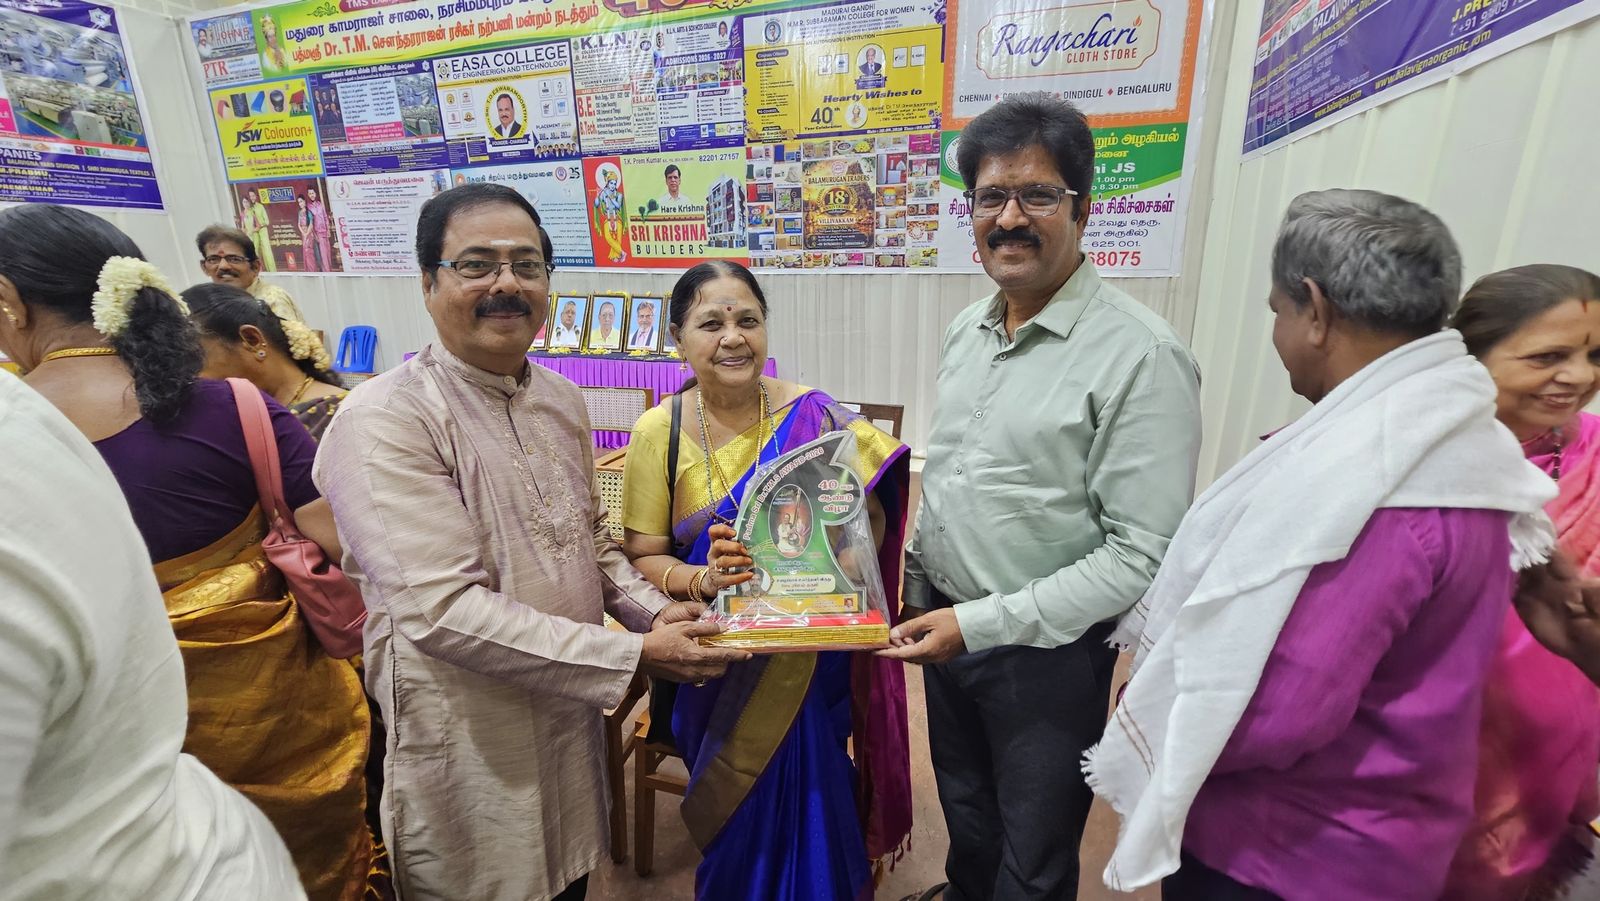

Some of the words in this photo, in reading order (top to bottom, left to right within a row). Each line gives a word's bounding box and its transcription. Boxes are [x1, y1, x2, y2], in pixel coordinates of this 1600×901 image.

[821, 7, 850, 16] MADURAI
[850, 3, 876, 13] GANDHI
[847, 10, 876, 20] COLLEGE
[876, 8, 889, 17] FOR
[889, 5, 915, 15] WOMEN
[286, 24, 325, 43] மதுரை
[329, 11, 384, 32] காமராஜர்
[389, 9, 434, 25] சாலை,
[324, 42, 342, 57] Dr.
[342, 34, 371, 54] T.M.
[373, 24, 446, 50] சௌந்தரராஜன்
[449, 19, 475, 41] ரசிகர்
[478, 12, 513, 37] நற்பணி
[516, 7, 552, 30] மன்றம்
[555, 1, 600, 25] நடத்தும்
[992, 13, 1137, 67] Rangachari
[451, 56, 490, 74] EASA
[493, 45, 568, 68] COLLEGE
[1067, 51, 1099, 64] CLOTH
[1103, 47, 1138, 61] STORE
[203, 60, 229, 79] PTR
[507, 65, 521, 73] AND
[521, 59, 569, 72] TECHNOLOGY
[823, 94, 863, 104] Hearty
[865, 90, 909, 99] Wishes
[909, 88, 923, 96] to
[959, 93, 992, 103] CHENNAI
[1063, 88, 1104, 100] DINDIGUL
[1117, 82, 1172, 96] BENGALURU
[811, 106, 834, 125] 40
[234, 129, 263, 149] JSW
[1121, 127, 1180, 148] அழகியல்
[646, 156, 662, 164] Kumar
[699, 154, 718, 162] 82201
[719, 152, 739, 161] 27157
[569, 167, 581, 180] 25
[1111, 161, 1136, 174] JS
[808, 175, 847, 185] BALAMURUGAN
[847, 173, 870, 183] TRADERS
[1118, 176, 1136, 184] pm
[1100, 183, 1120, 191] 8.30
[1122, 183, 1140, 191] pm
[828, 190, 846, 205] 18
[1106, 192, 1175, 214] சிகிச்சைகள்
[661, 205, 677, 213] Hare
[677, 204, 704, 213] Krishna
[1099, 219, 1128, 228] 2வது
[1130, 219, 1161, 227] தெரு.
[631, 224, 650, 242] SRI
[653, 223, 707, 242] KRISHNA
[1104, 228, 1149, 239] அருகில்)
[636, 244, 704, 255] BUILDERS
[1091, 240, 1115, 248] 625
[1118, 240, 1141, 248] 001.
[818, 479, 839, 491] 40
[822, 503, 850, 513] விழா
[743, 512, 757, 541] Padma
[751, 500, 762, 515] Sri
